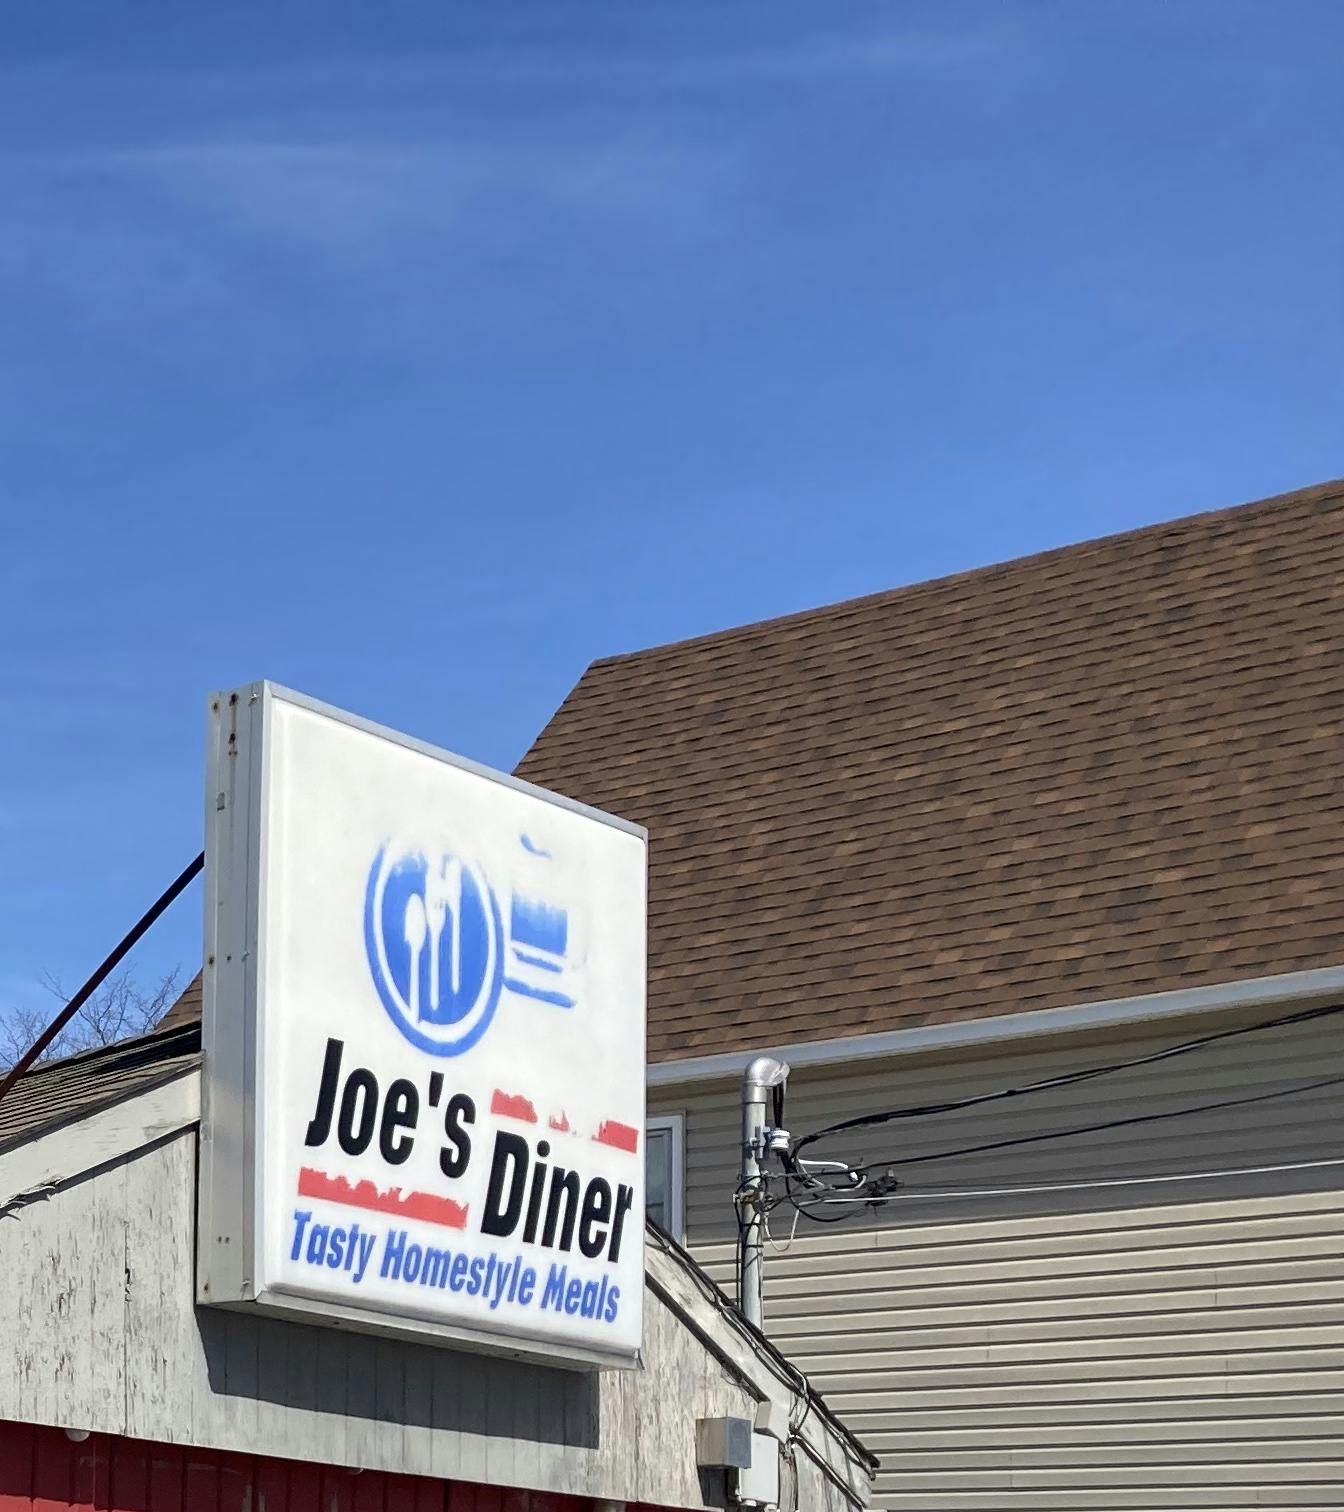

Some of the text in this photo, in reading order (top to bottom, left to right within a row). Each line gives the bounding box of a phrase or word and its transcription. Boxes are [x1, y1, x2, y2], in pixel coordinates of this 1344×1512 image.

[305, 1037, 634, 1263] Joe's Diner
[290, 1208, 621, 1323] Tasty Homestyle Meals
